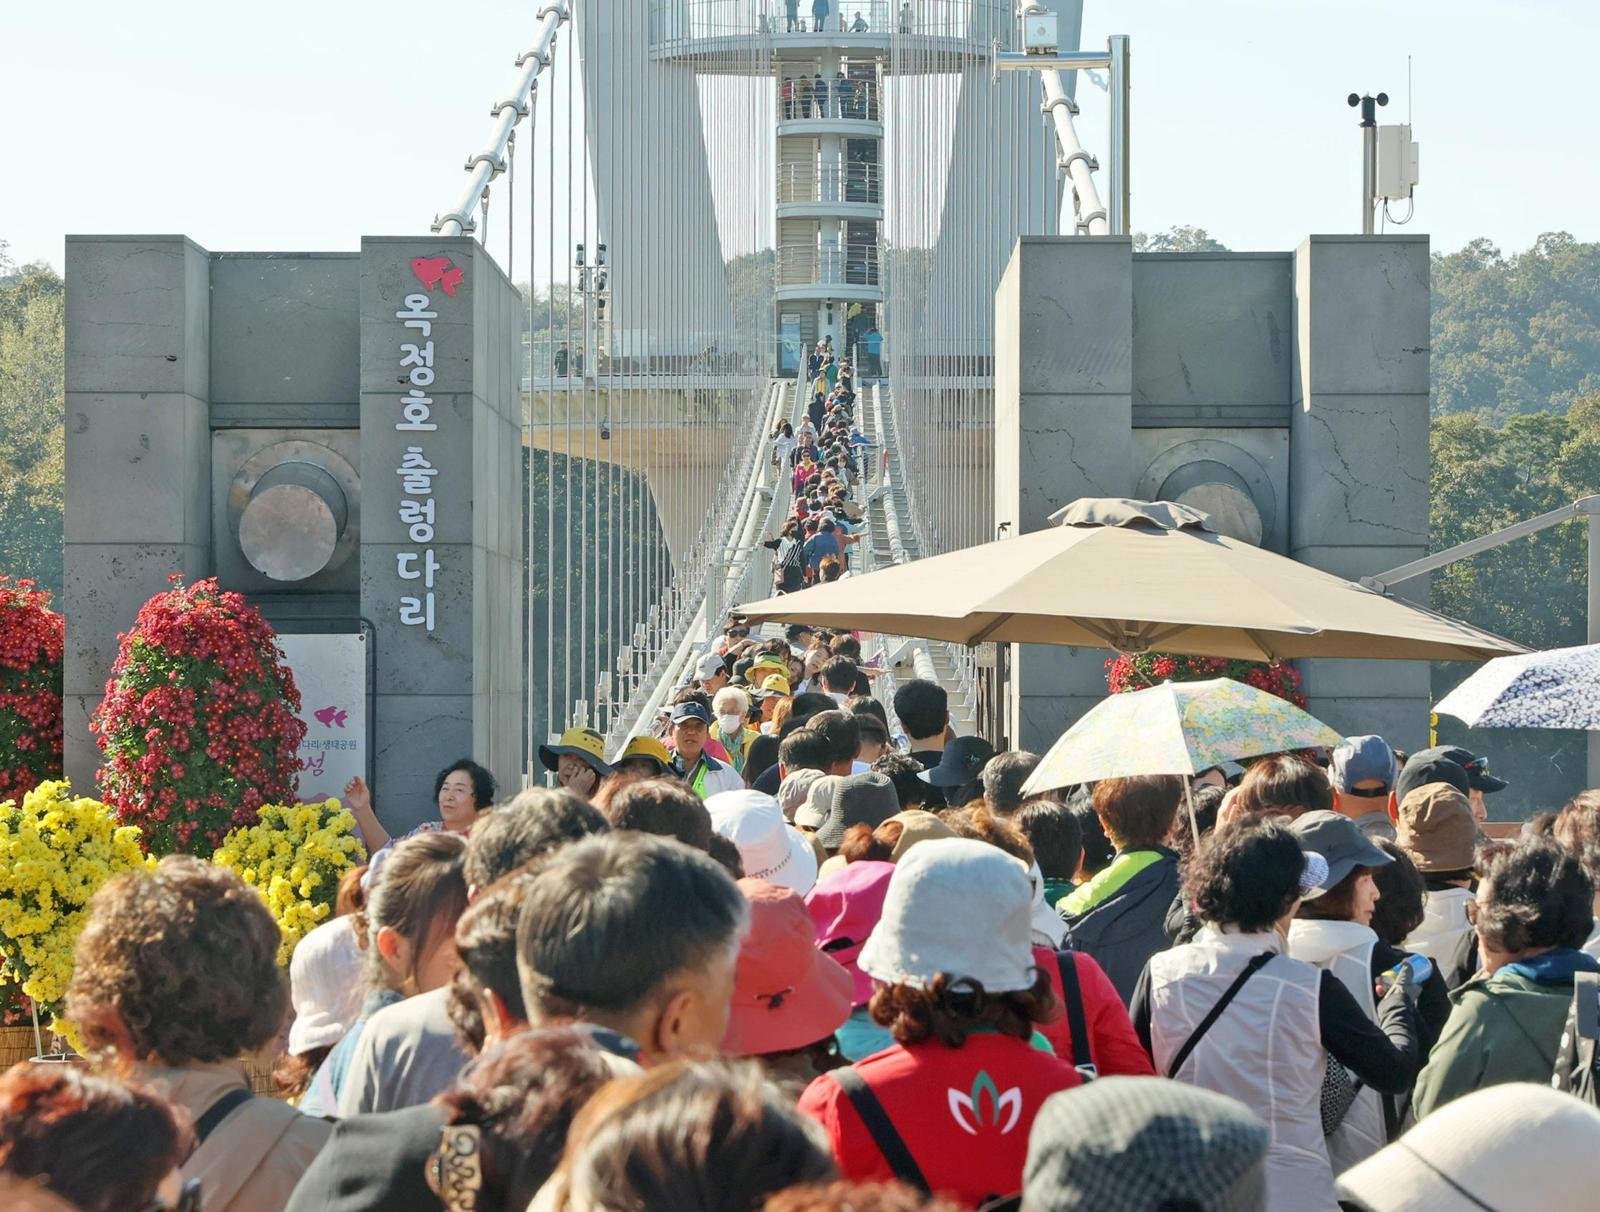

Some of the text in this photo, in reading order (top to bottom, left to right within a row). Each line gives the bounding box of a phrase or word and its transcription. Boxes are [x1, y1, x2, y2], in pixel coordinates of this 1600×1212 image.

[395, 293, 441, 631] 옥정호 출렁다리
[299, 739, 357, 750] 다리/생태공원
